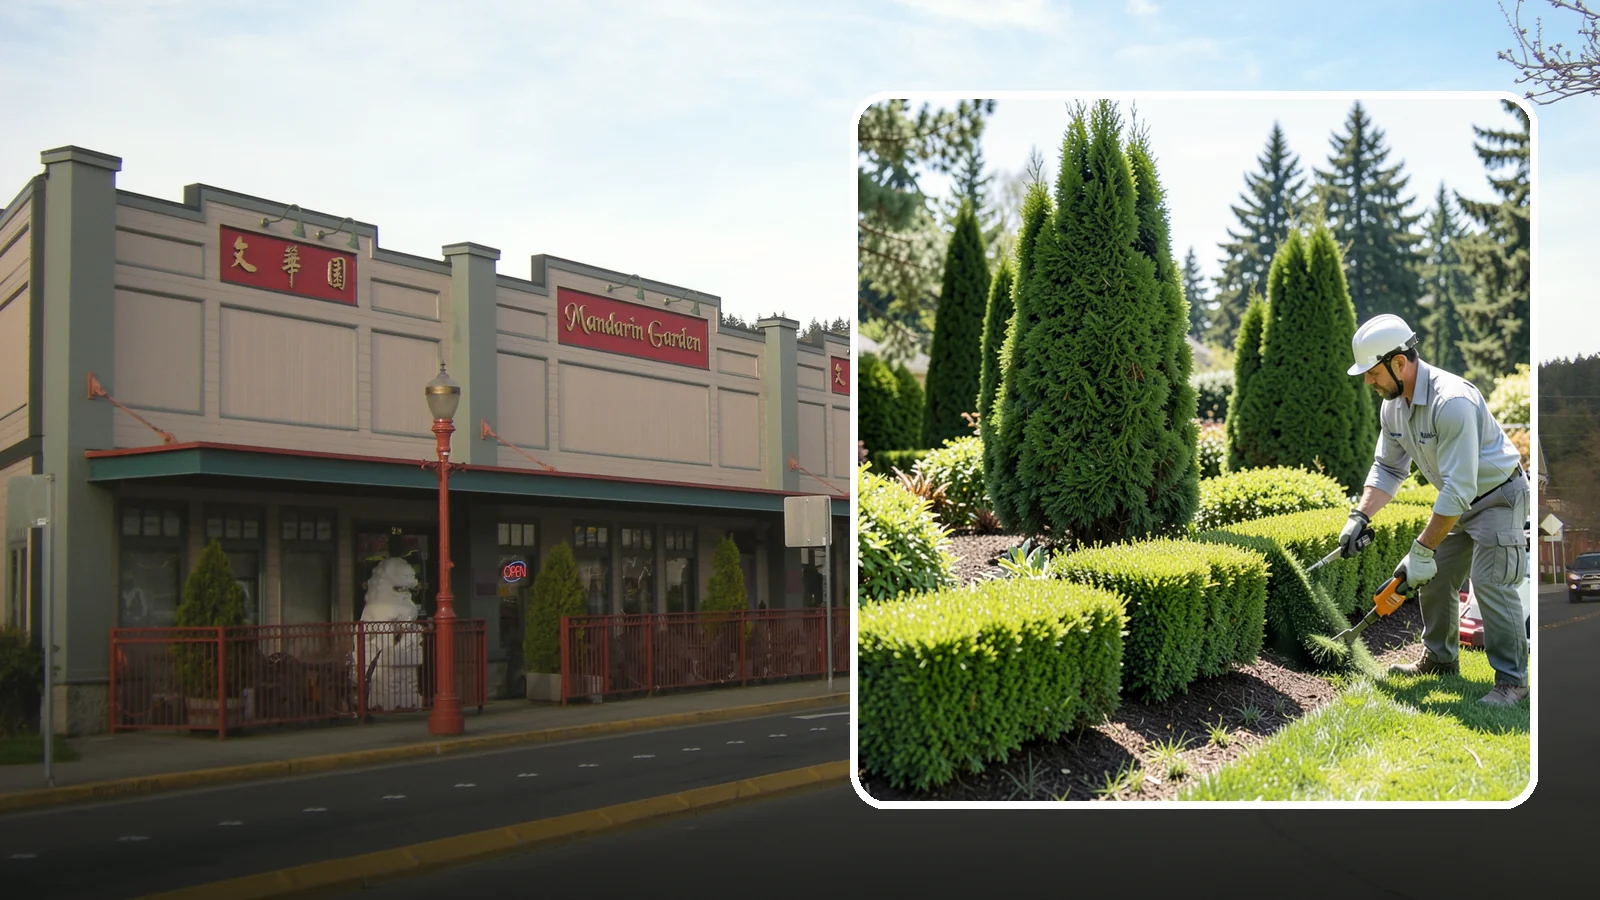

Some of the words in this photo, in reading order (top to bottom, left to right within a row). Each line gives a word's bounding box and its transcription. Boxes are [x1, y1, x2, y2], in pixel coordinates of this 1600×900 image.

[231, 236, 346, 290] 文華園
[564, 302, 644, 341] Mandarin
[648, 320, 701, 352] Garden
[503, 565, 527, 579] OPEN
